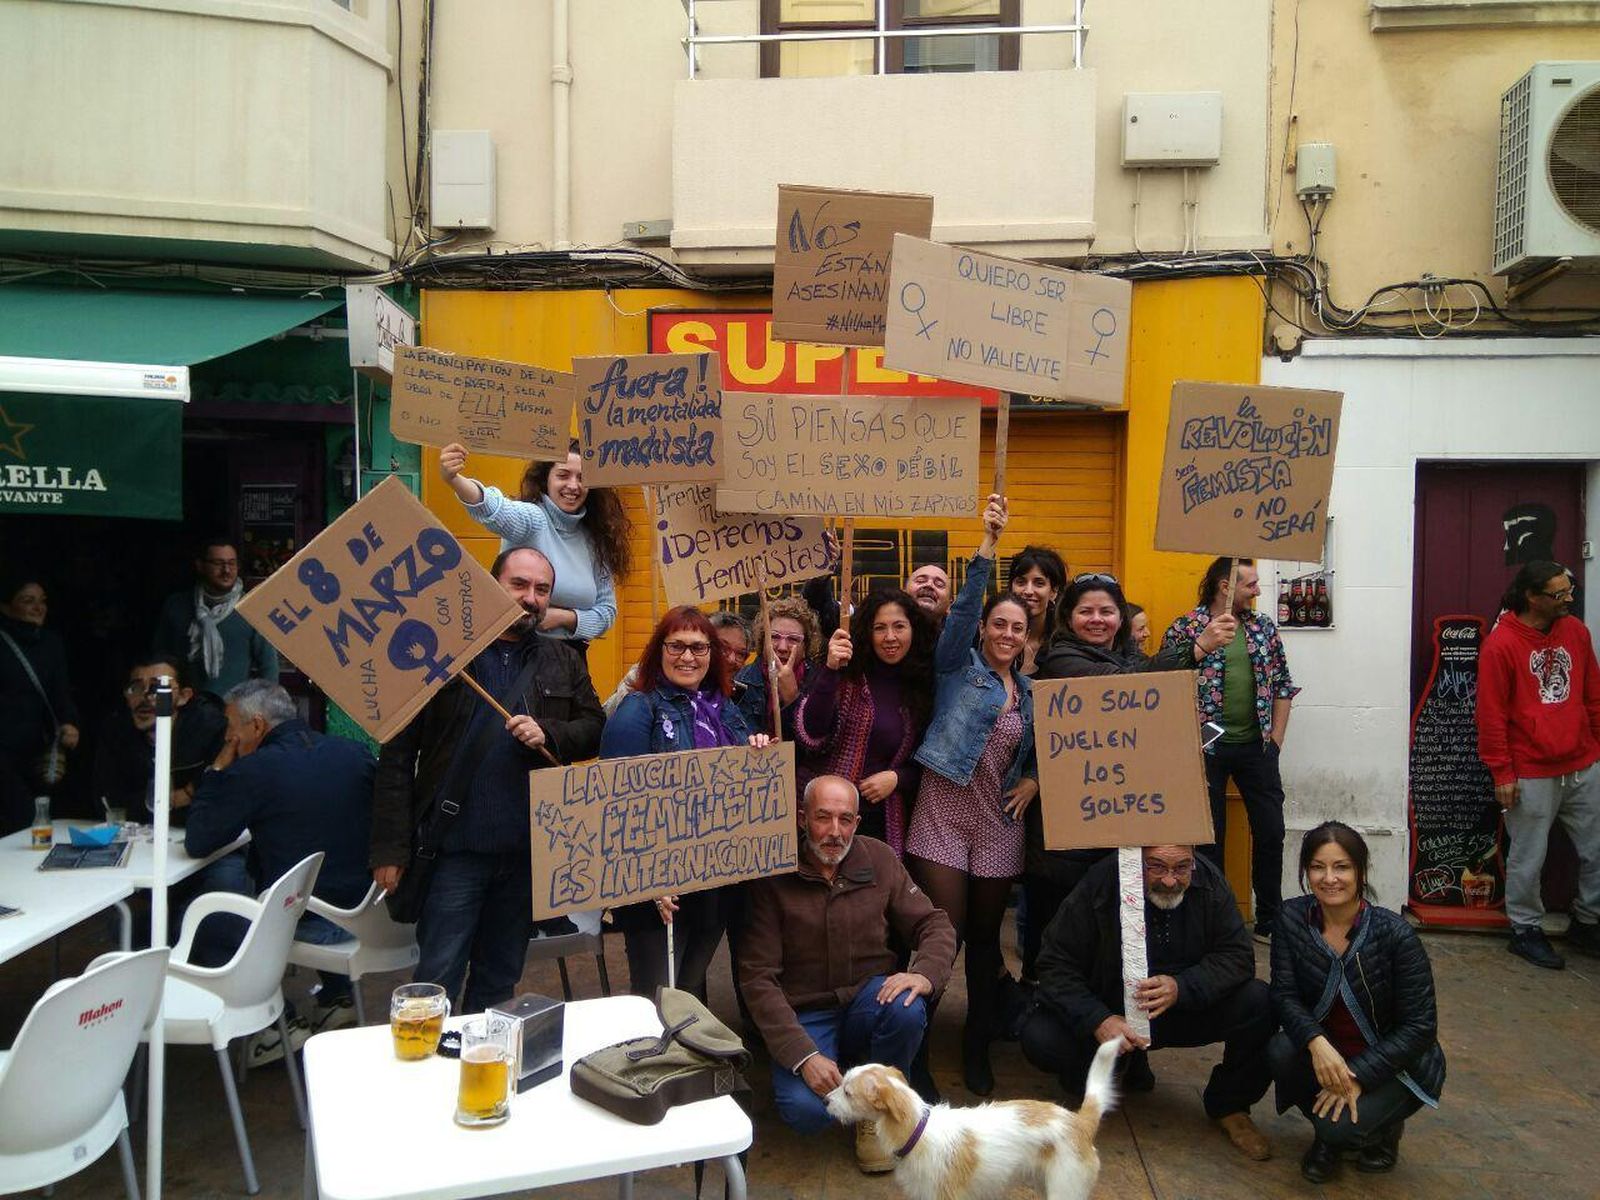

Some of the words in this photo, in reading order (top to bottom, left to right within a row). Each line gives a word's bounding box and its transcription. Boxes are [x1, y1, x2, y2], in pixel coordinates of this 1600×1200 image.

[815, 251, 891, 277] ESTÁN
[958, 255, 1031, 291] QUIERO
[1034, 277, 1066, 303] SER
[990, 301, 1048, 335] LIBRE
[402, 366, 450, 383] CLASE
[947, 338, 972, 361] NO
[980, 343, 1061, 381] VALIENTE
[520, 370, 536, 380] DE
[541, 374, 555, 385] LA
[458, 391, 506, 418] ELLA
[607, 398, 625, 428] la
[627, 390, 722, 425] mentalidad
[914, 412, 967, 443] QUE
[786, 453, 814, 476] EL
[819, 452, 887, 480] SEXO
[0, 490, 63, 503] VANTE
[844, 491, 865, 513] EN
[910, 493, 977, 513] ZAPATOS
[1256, 497, 1286, 520] NO
[1258, 499, 1322, 542] SERÁ
[267, 598, 312, 635] EL
[297, 558, 341, 605] 8
[346, 521, 384, 566] DE
[322, 528, 462, 668] MARZO
[437, 596, 451, 625] CON
[459, 571, 474, 641] NOSOTRAS
[360, 659, 380, 721] LUCHA
[1048, 684, 1082, 718] NO
[1100, 688, 1160, 712] SOLO
[1048, 728, 1137, 759] DUELEN
[563, 764, 608, 806] LA
[611, 756, 704, 798] LUCHA
[1084, 760, 1125, 785] LOS
[601, 775, 788, 856] FEMINISTA
[1080, 793, 1165, 821] GOLPES
[550, 860, 596, 908] ES
[600, 833, 797, 899] INTERNACIONAL
